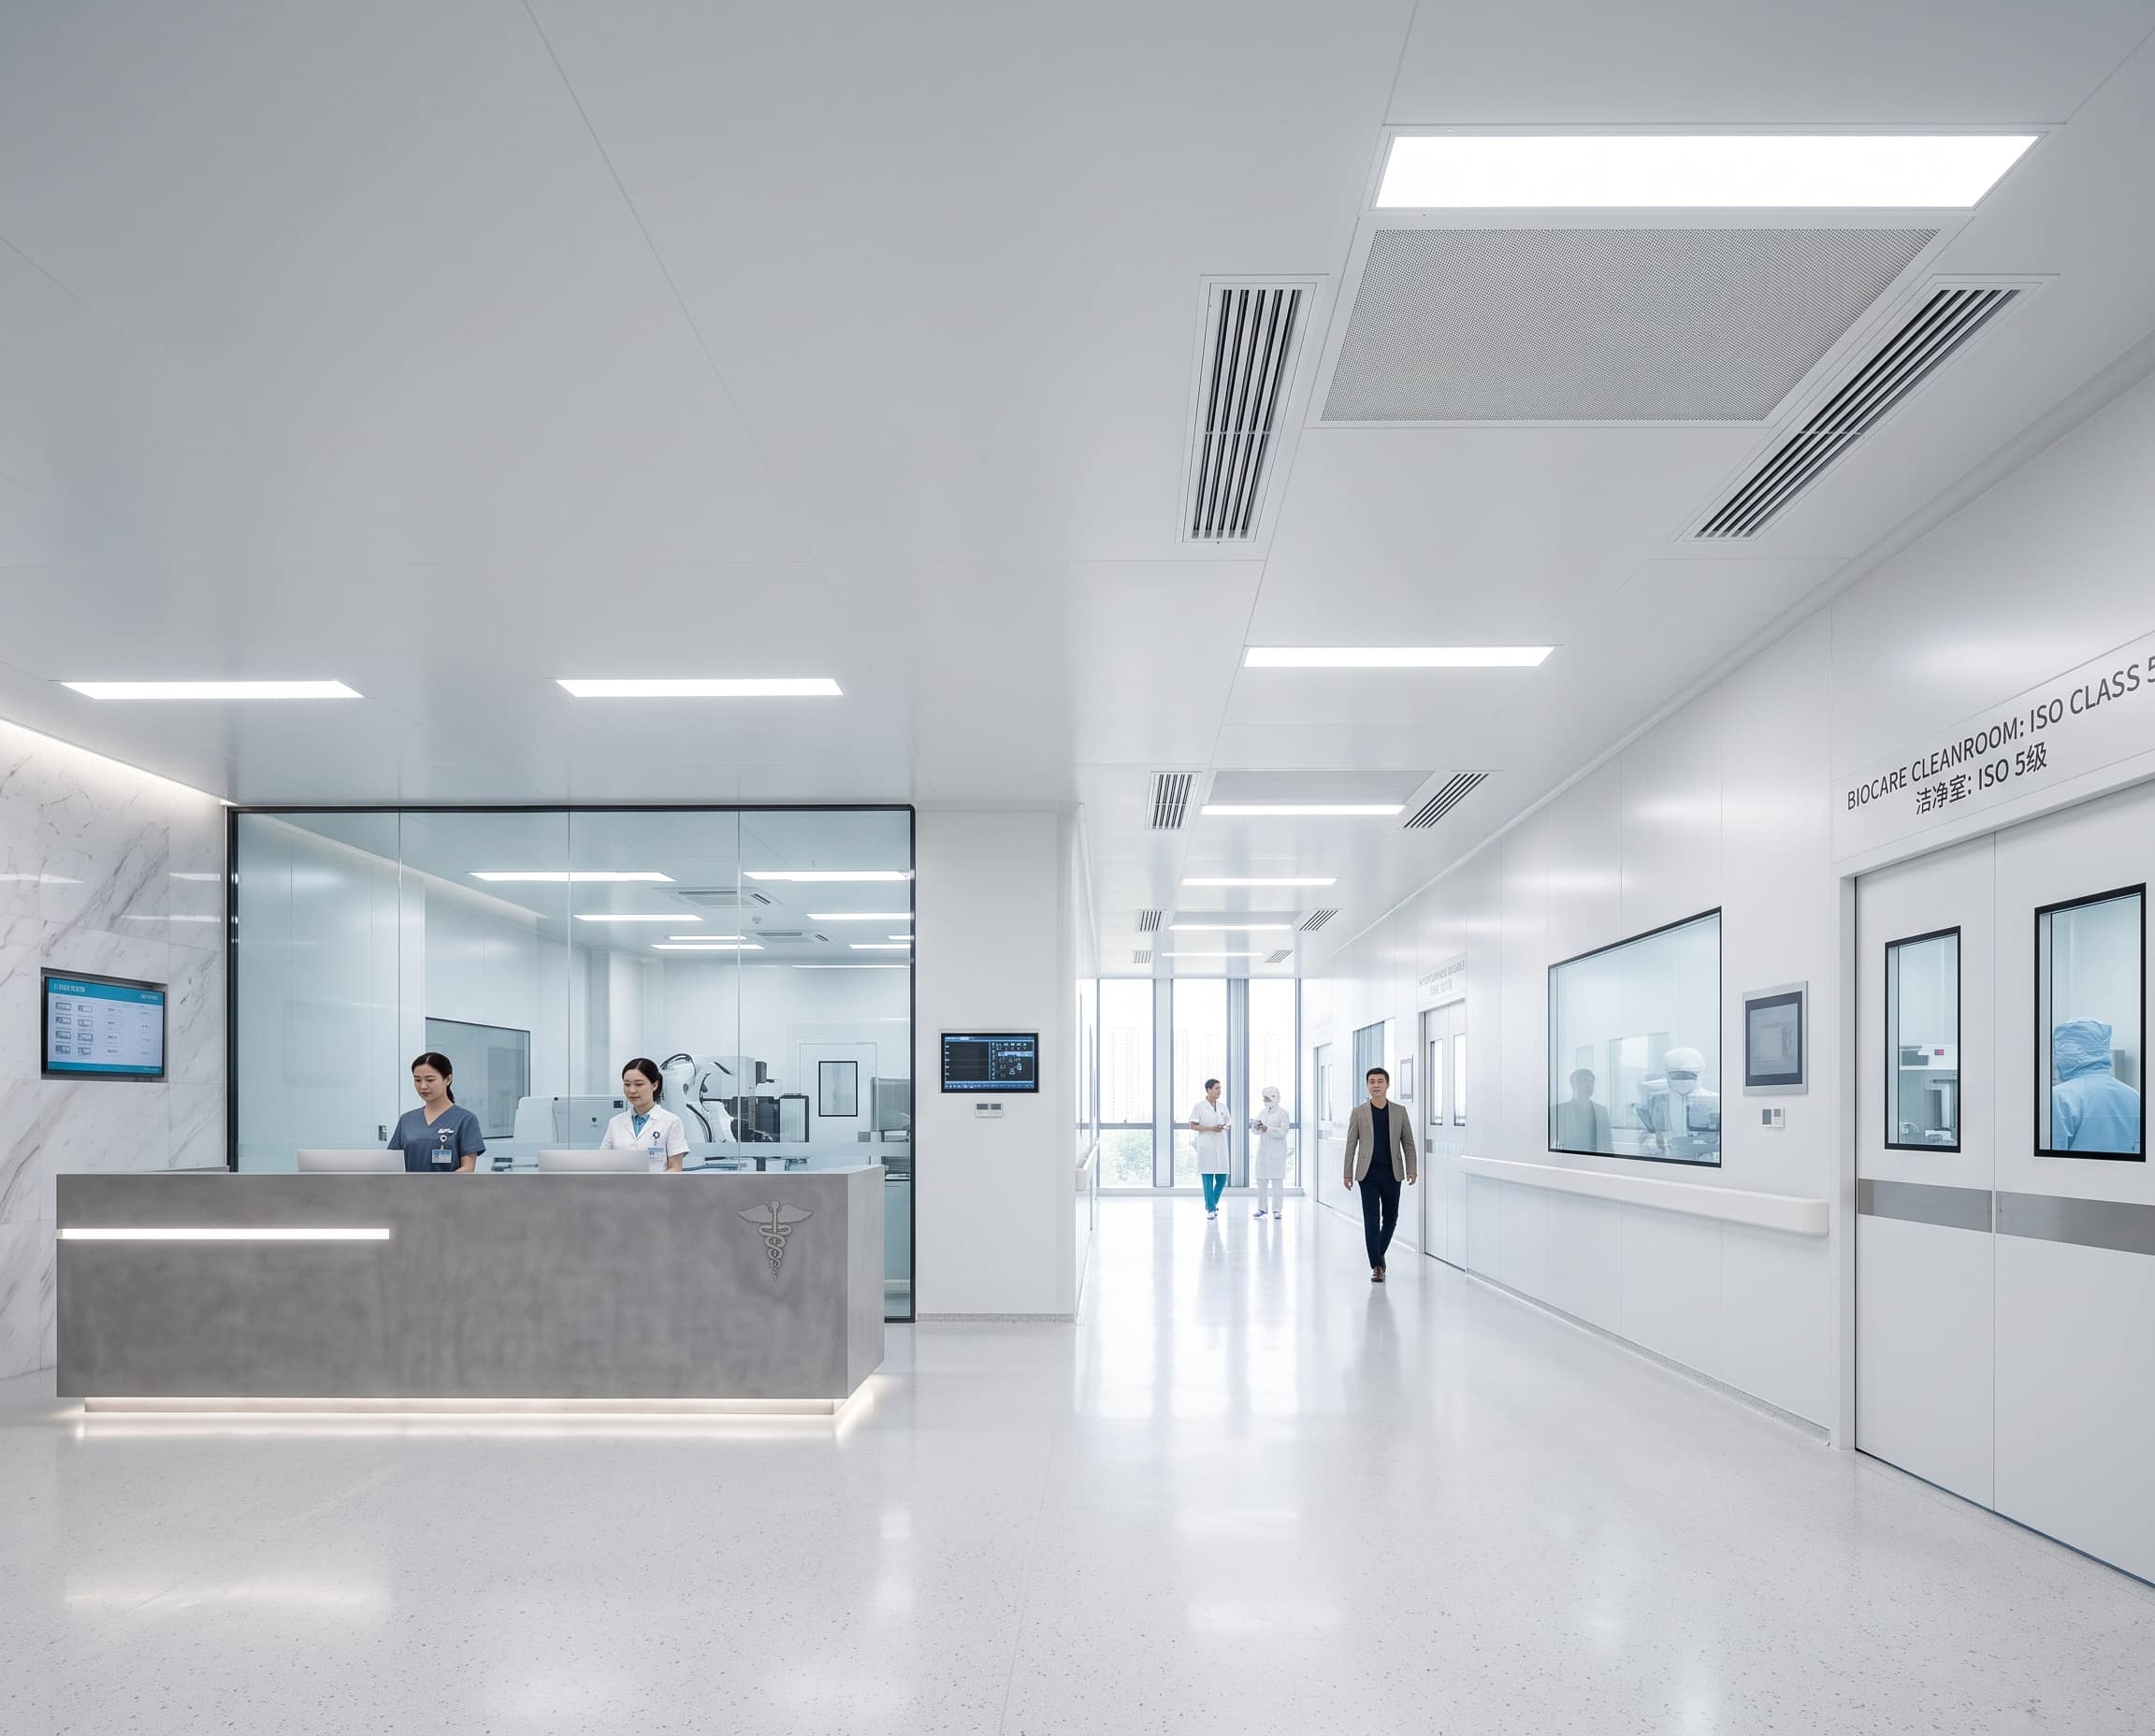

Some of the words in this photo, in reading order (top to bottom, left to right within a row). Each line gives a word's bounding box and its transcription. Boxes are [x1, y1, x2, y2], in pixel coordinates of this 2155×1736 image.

[1847, 768, 1908, 811] BIOCARE
[1912, 717, 2025, 782] CLEANROOM:
[2030, 699, 2062, 732] ISO
[2069, 664, 2140, 715] CLASS
[1978, 759, 2009, 790] ISO
[2015, 741, 2047, 776] 5级
